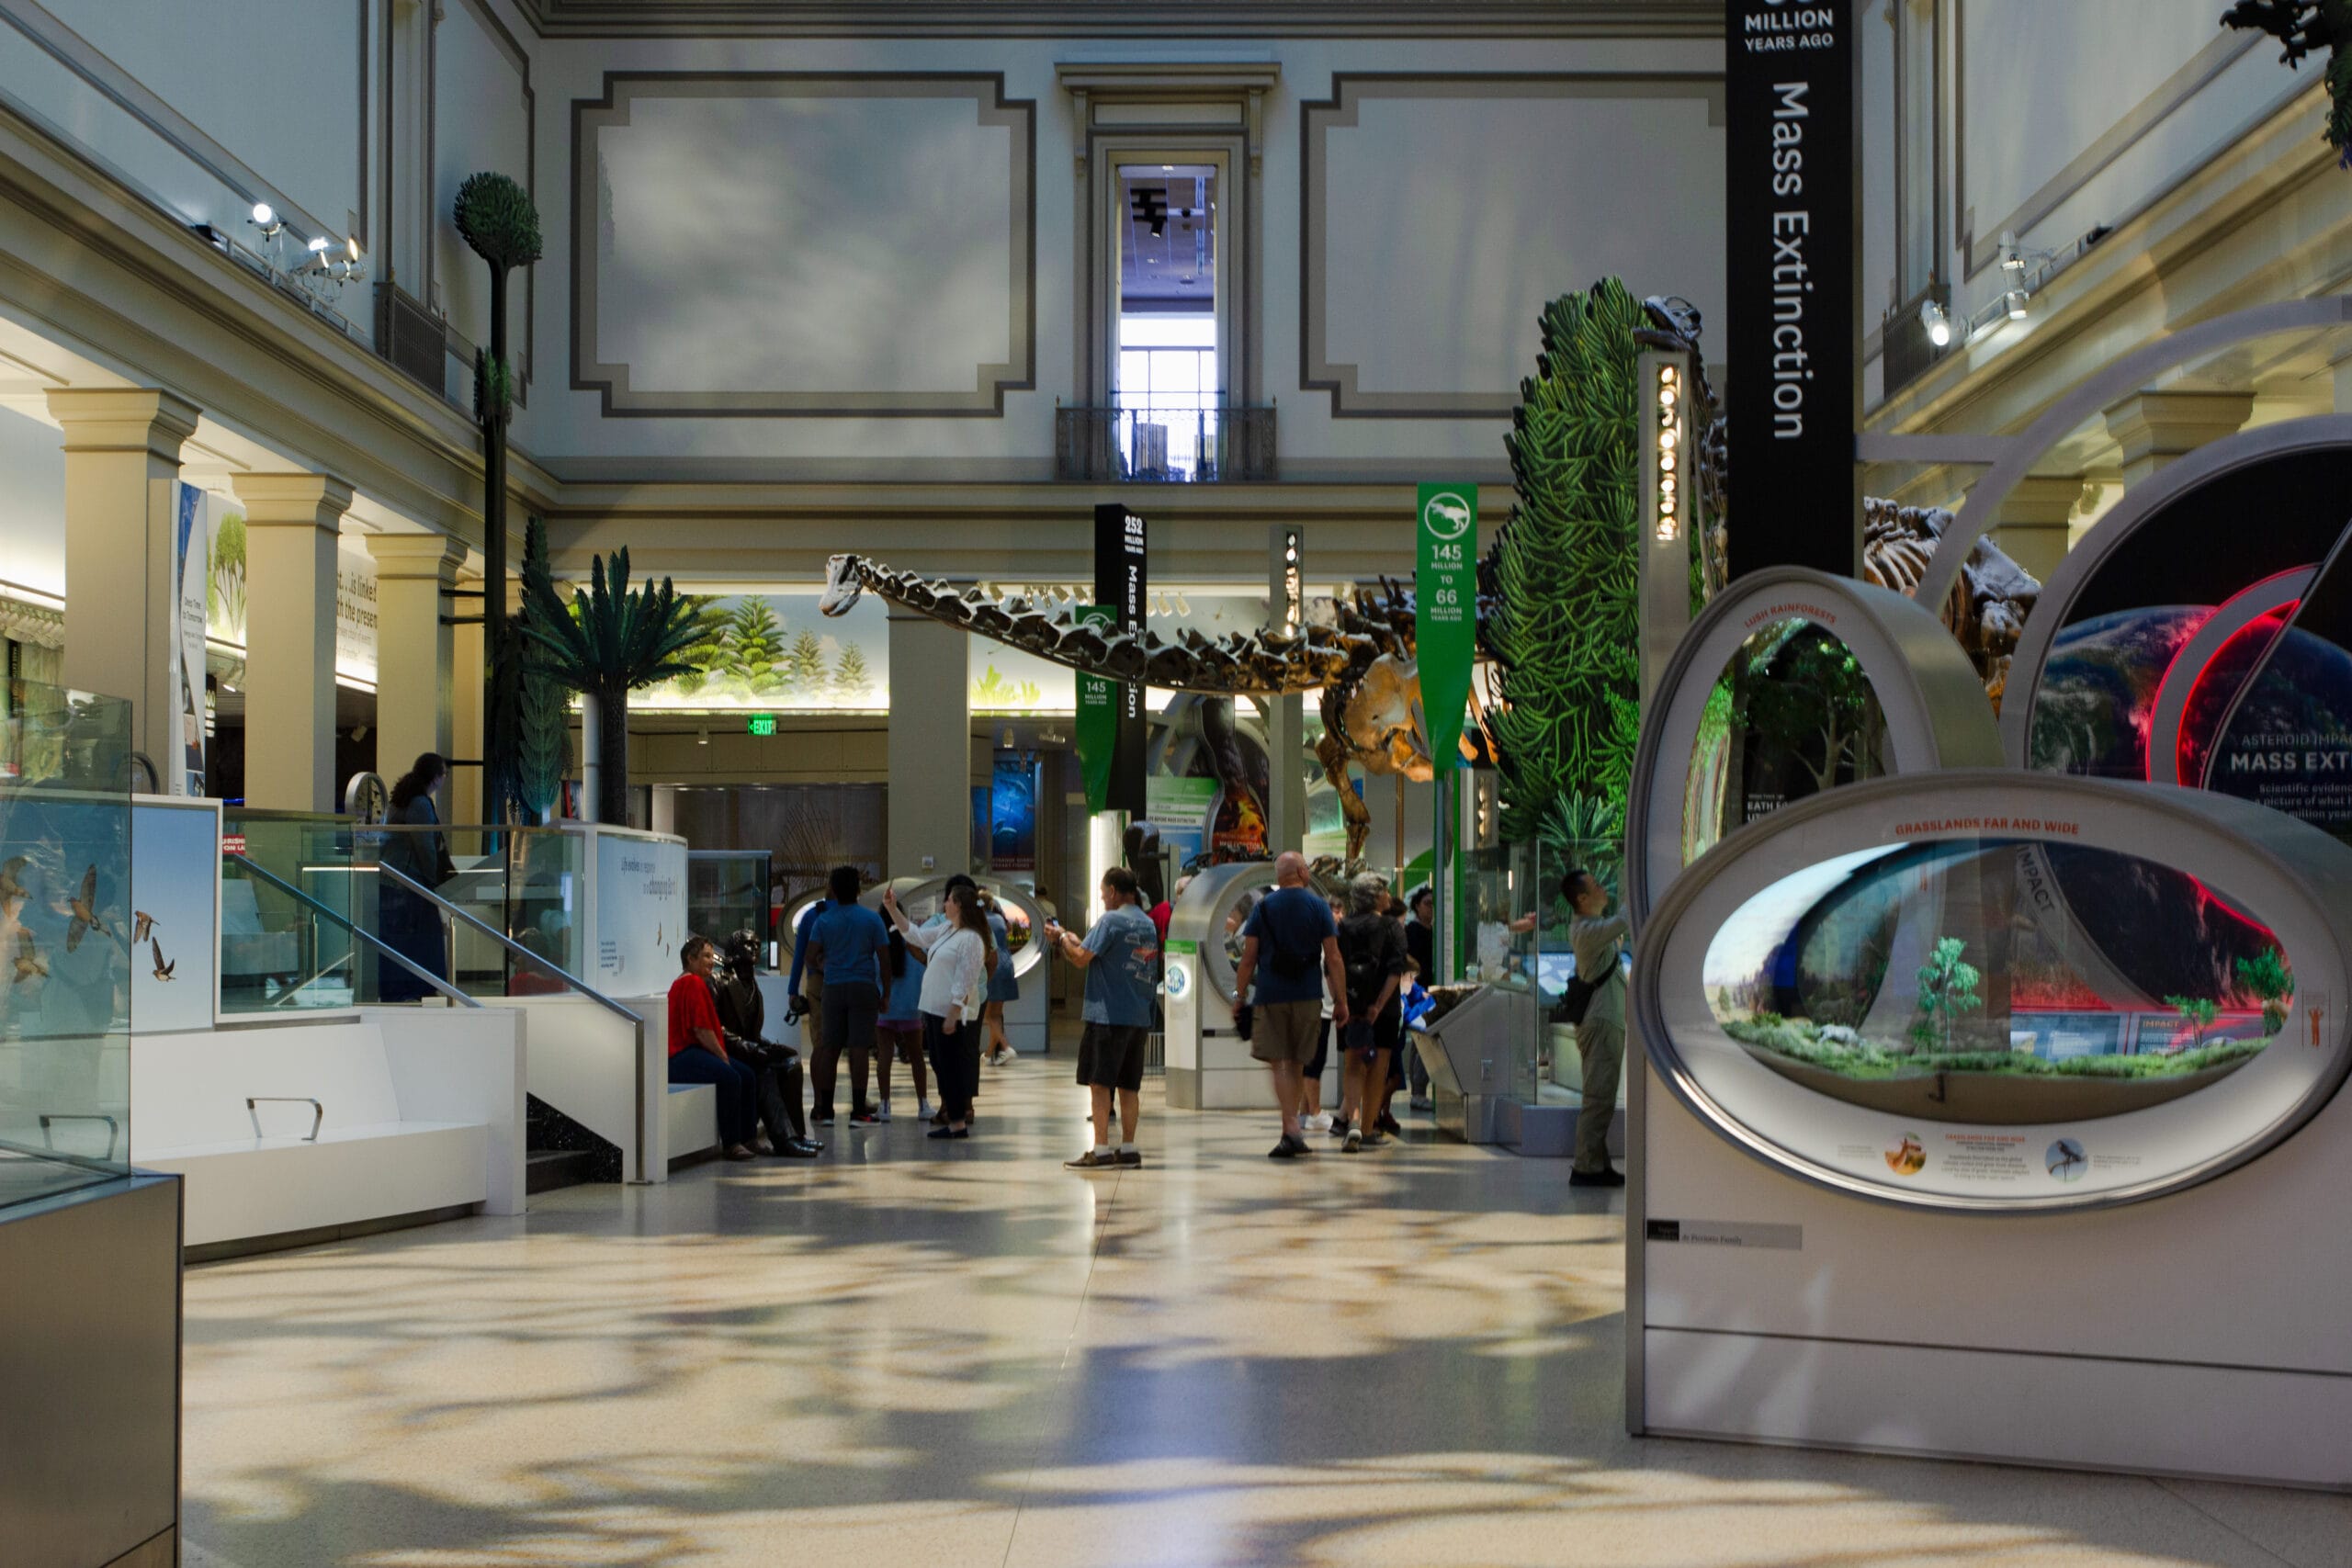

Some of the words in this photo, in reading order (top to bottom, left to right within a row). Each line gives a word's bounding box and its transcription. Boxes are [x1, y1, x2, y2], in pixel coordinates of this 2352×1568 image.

[1745, 9, 1833, 31] MILLION
[1745, 35, 1795, 52] YEARS
[1799, 33, 1834, 49] AGO
[1772, 82, 1809, 197] Mass
[1772, 210, 1814, 439] Extinction
[1125, 514, 1143, 535] 252
[1125, 535, 1144, 547] MILLION
[1431, 544, 1462, 560] 145
[1430, 562, 1463, 570] MILLION
[1440, 574, 1453, 584] TO
[1128, 565, 1137, 615] Mass
[1436, 589, 1457, 604] 66
[1770, 602, 1838, 626] RAINFORESTS
[1086, 681, 1106, 693] 145
[753, 719, 775, 735] EXIT
[2242, 734, 2310, 746] ASTEROID
[2231, 751, 2298, 772] MASS
[2305, 751, 2352, 771] EXT
[2259, 784, 2309, 794] Scientific
[2304, 795, 2315, 806] of
[2318, 795, 2343, 806] what
[1896, 818, 1980, 836] GRASSLANDS
[1984, 818, 2007, 829] FAR
[2012, 818, 2041, 830] AND
[2044, 820, 2079, 835] WIDE
[2018, 845, 2055, 912] IMPACT
